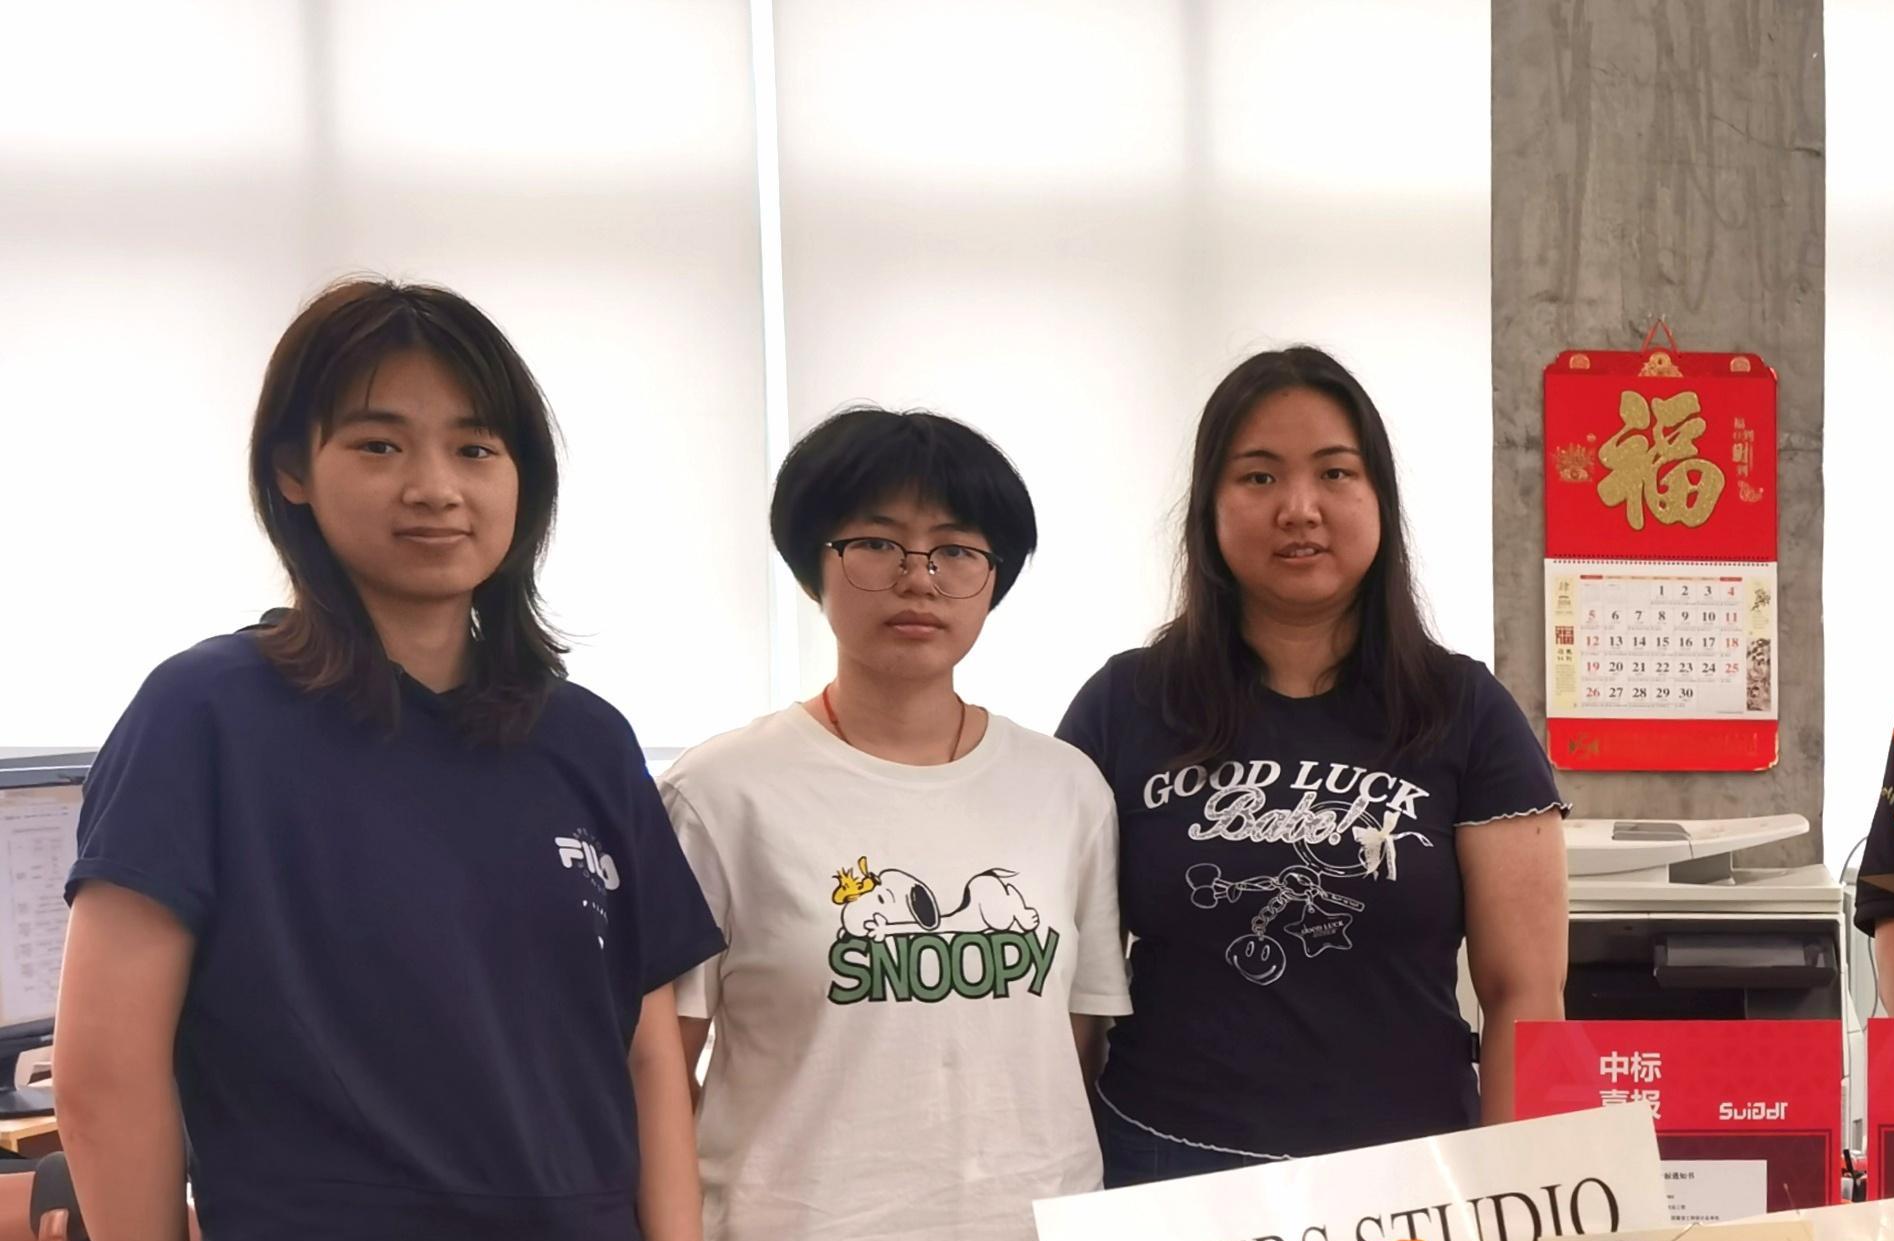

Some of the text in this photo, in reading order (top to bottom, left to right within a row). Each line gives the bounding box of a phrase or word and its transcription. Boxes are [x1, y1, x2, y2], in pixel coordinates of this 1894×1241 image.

[1596, 390, 1726, 531] 福
[1659, 585, 1735, 596] 1 2 3 4
[1588, 609, 1737, 622] 5 6 7 8 9 10 11
[1586, 636, 1739, 648] 12 13 14 15 16 17 18
[1586, 662, 1739, 673] 19 20 21 22 23 24 25
[1586, 687, 1693, 699] 26 27 28 29 30
[1143, 760, 1430, 820] GOOD LUCK
[827, 926, 1060, 1006] SNOOPY
[1599, 1051, 1662, 1083] 中标
